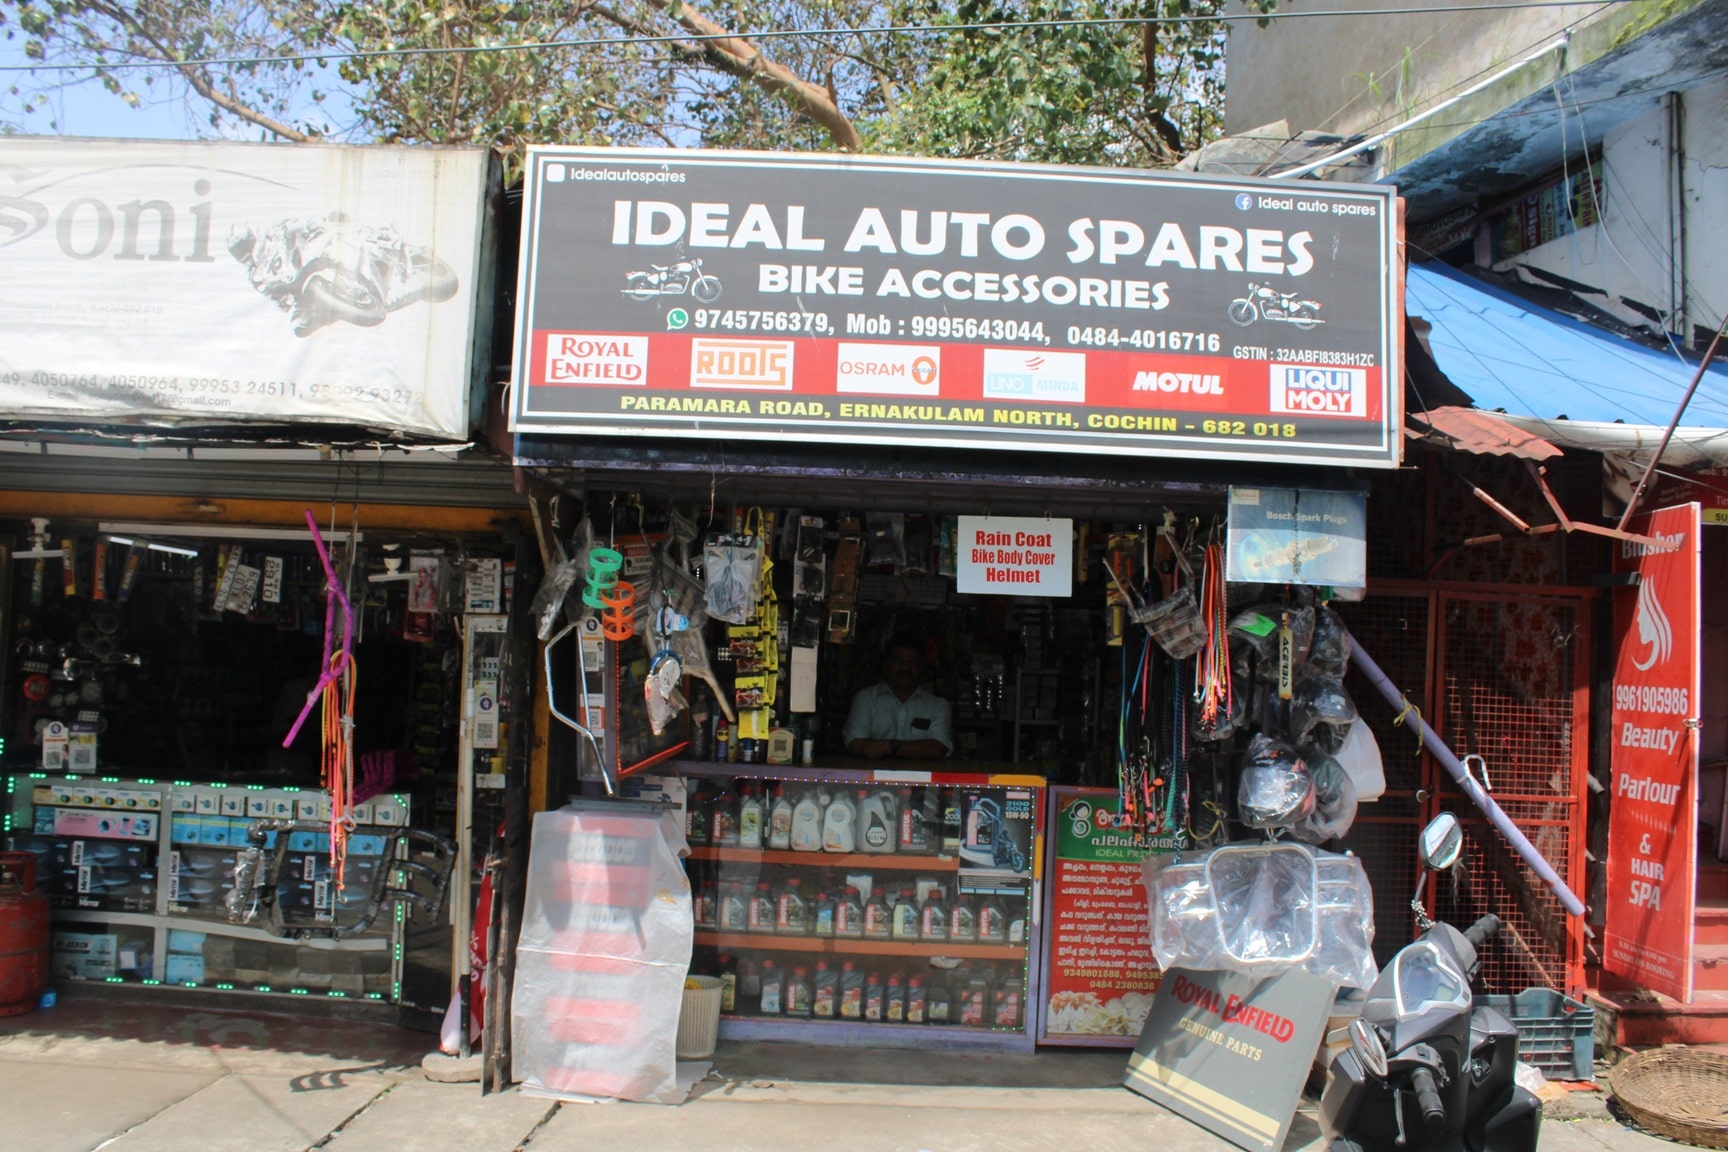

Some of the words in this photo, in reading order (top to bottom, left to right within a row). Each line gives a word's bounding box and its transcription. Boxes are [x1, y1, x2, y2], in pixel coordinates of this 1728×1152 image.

[570, 167, 686, 184] Idealautospares
[1257, 196, 1294, 211] Ideal
[1296, 201, 1328, 213] auto
[1331, 203, 1376, 217] spares
[611, 199, 825, 251] IDEAL
[843, 206, 1046, 261] AUTO
[1066, 217, 1315, 277] SPARES
[758, 263, 864, 296] BIKE
[876, 267, 1170, 311] ACCESSORIES
[694, 309, 835, 336] 9745756379,
[846, 312, 891, 336] Mob
[911, 314, 1051, 346] 9995643044,
[1067, 326, 1221, 352] 0484-4016716
[560, 337, 634, 359] ROYAL
[1232, 346, 1268, 361] GSTIN
[550, 358, 643, 381] ENFIELD
[697, 348, 787, 386] ROOTS
[839, 361, 905, 377] OSRAM
[189, 377, 241, 394] 99953
[247, 381, 303, 400] 24511,
[989, 373, 1024, 393] UNO
[1036, 377, 1079, 394] MINDA
[1132, 370, 1224, 395] MOTUL
[1287, 368, 1351, 393] LIQUI
[1287, 391, 1351, 412] MOLY
[620, 394, 751, 415] PARAMARA
[758, 399, 831, 419] ROAD,
[839, 402, 985, 423] ERNAKULAM
[993, 409, 1079, 429] NORTH,
[1087, 413, 1178, 432] COCHIN
[1202, 419, 1245, 436] 682
[1253, 421, 1296, 438] 018
[1266, 510, 1293, 520] Bosch
[1296, 512, 1321, 523] Spark
[1323, 514, 1347, 525] Plugs
[975, 530, 1011, 546] Rain
[1015, 531, 1052, 547] Coat
[971, 548, 995, 564] Bike
[997, 549, 1023, 566] Body
[1025, 550, 1056, 565] Cover
[986, 567, 1041, 583] Helmet
[1616, 684, 1689, 716] 9961905986
[1621, 720, 1679, 756] Beauty
[1619, 772, 1682, 805] Parlour
[1095, 848, 1125, 858] IDEAL
[1638, 833, 1651, 855] &
[1631, 857, 1665, 881] HAIR
[1629, 880, 1661, 911] SPA
[1090, 981, 1113, 989] 0484
[1171, 974, 1220, 1014] ROYAL
[1221, 993, 1294, 1043] ENFIELD
[1179, 1017, 1225, 1046] GENUINE
[1226, 1036, 1263, 1062] PARTS
